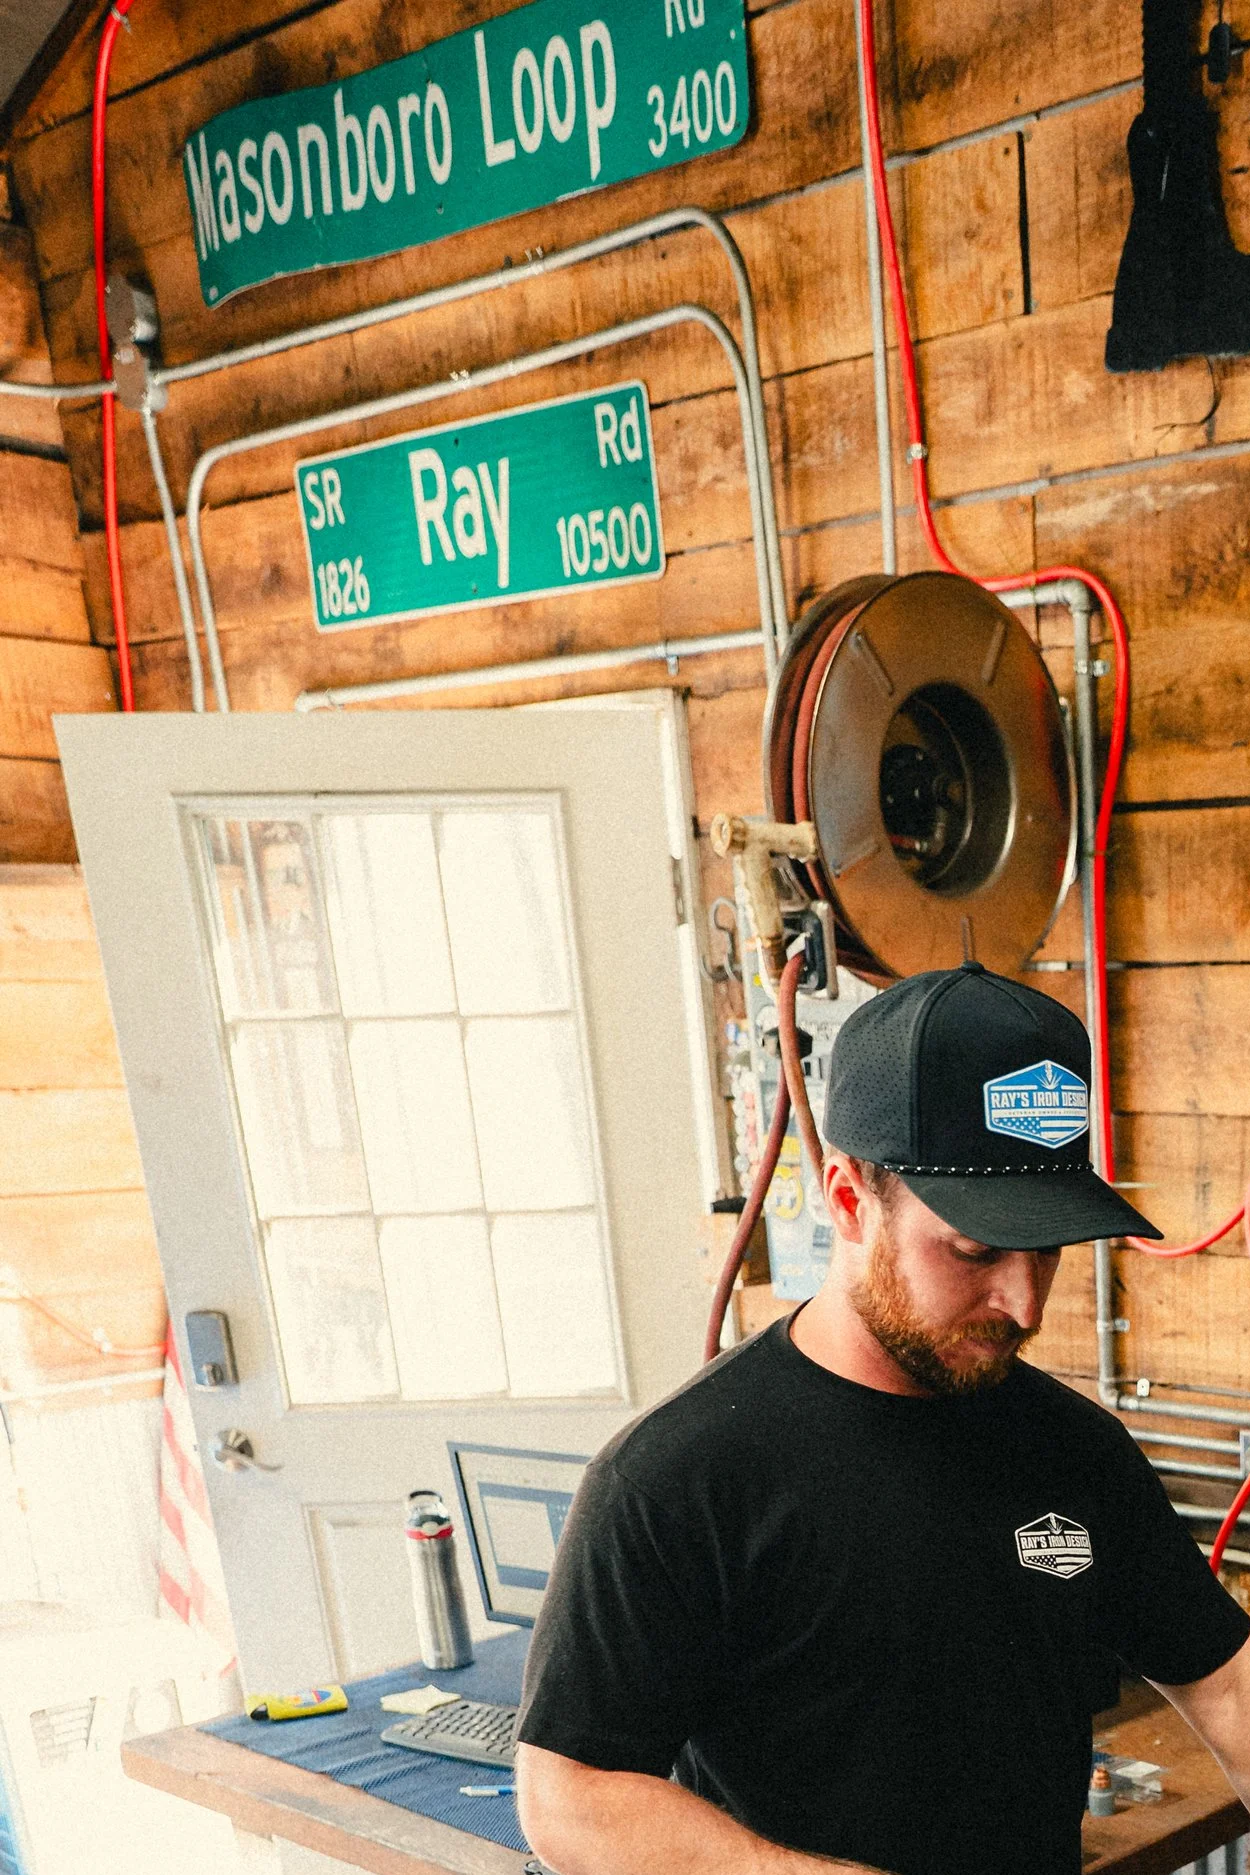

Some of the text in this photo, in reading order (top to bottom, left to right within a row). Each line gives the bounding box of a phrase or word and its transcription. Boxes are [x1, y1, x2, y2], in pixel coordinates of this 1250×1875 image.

[185, 19, 617, 261] Masonboro Loop
[646, 61, 737, 158] 3400
[594, 396, 643, 468] Rd
[303, 467, 345, 531] SR
[408, 447, 510, 589] Ray
[555, 501, 653, 578] 10500
[316, 555, 370, 619] 1826
[991, 1092, 1029, 1108] RAY'S
[1033, 1091, 1060, 1107] IRON
[1021, 1536, 1047, 1549] RAY'S
